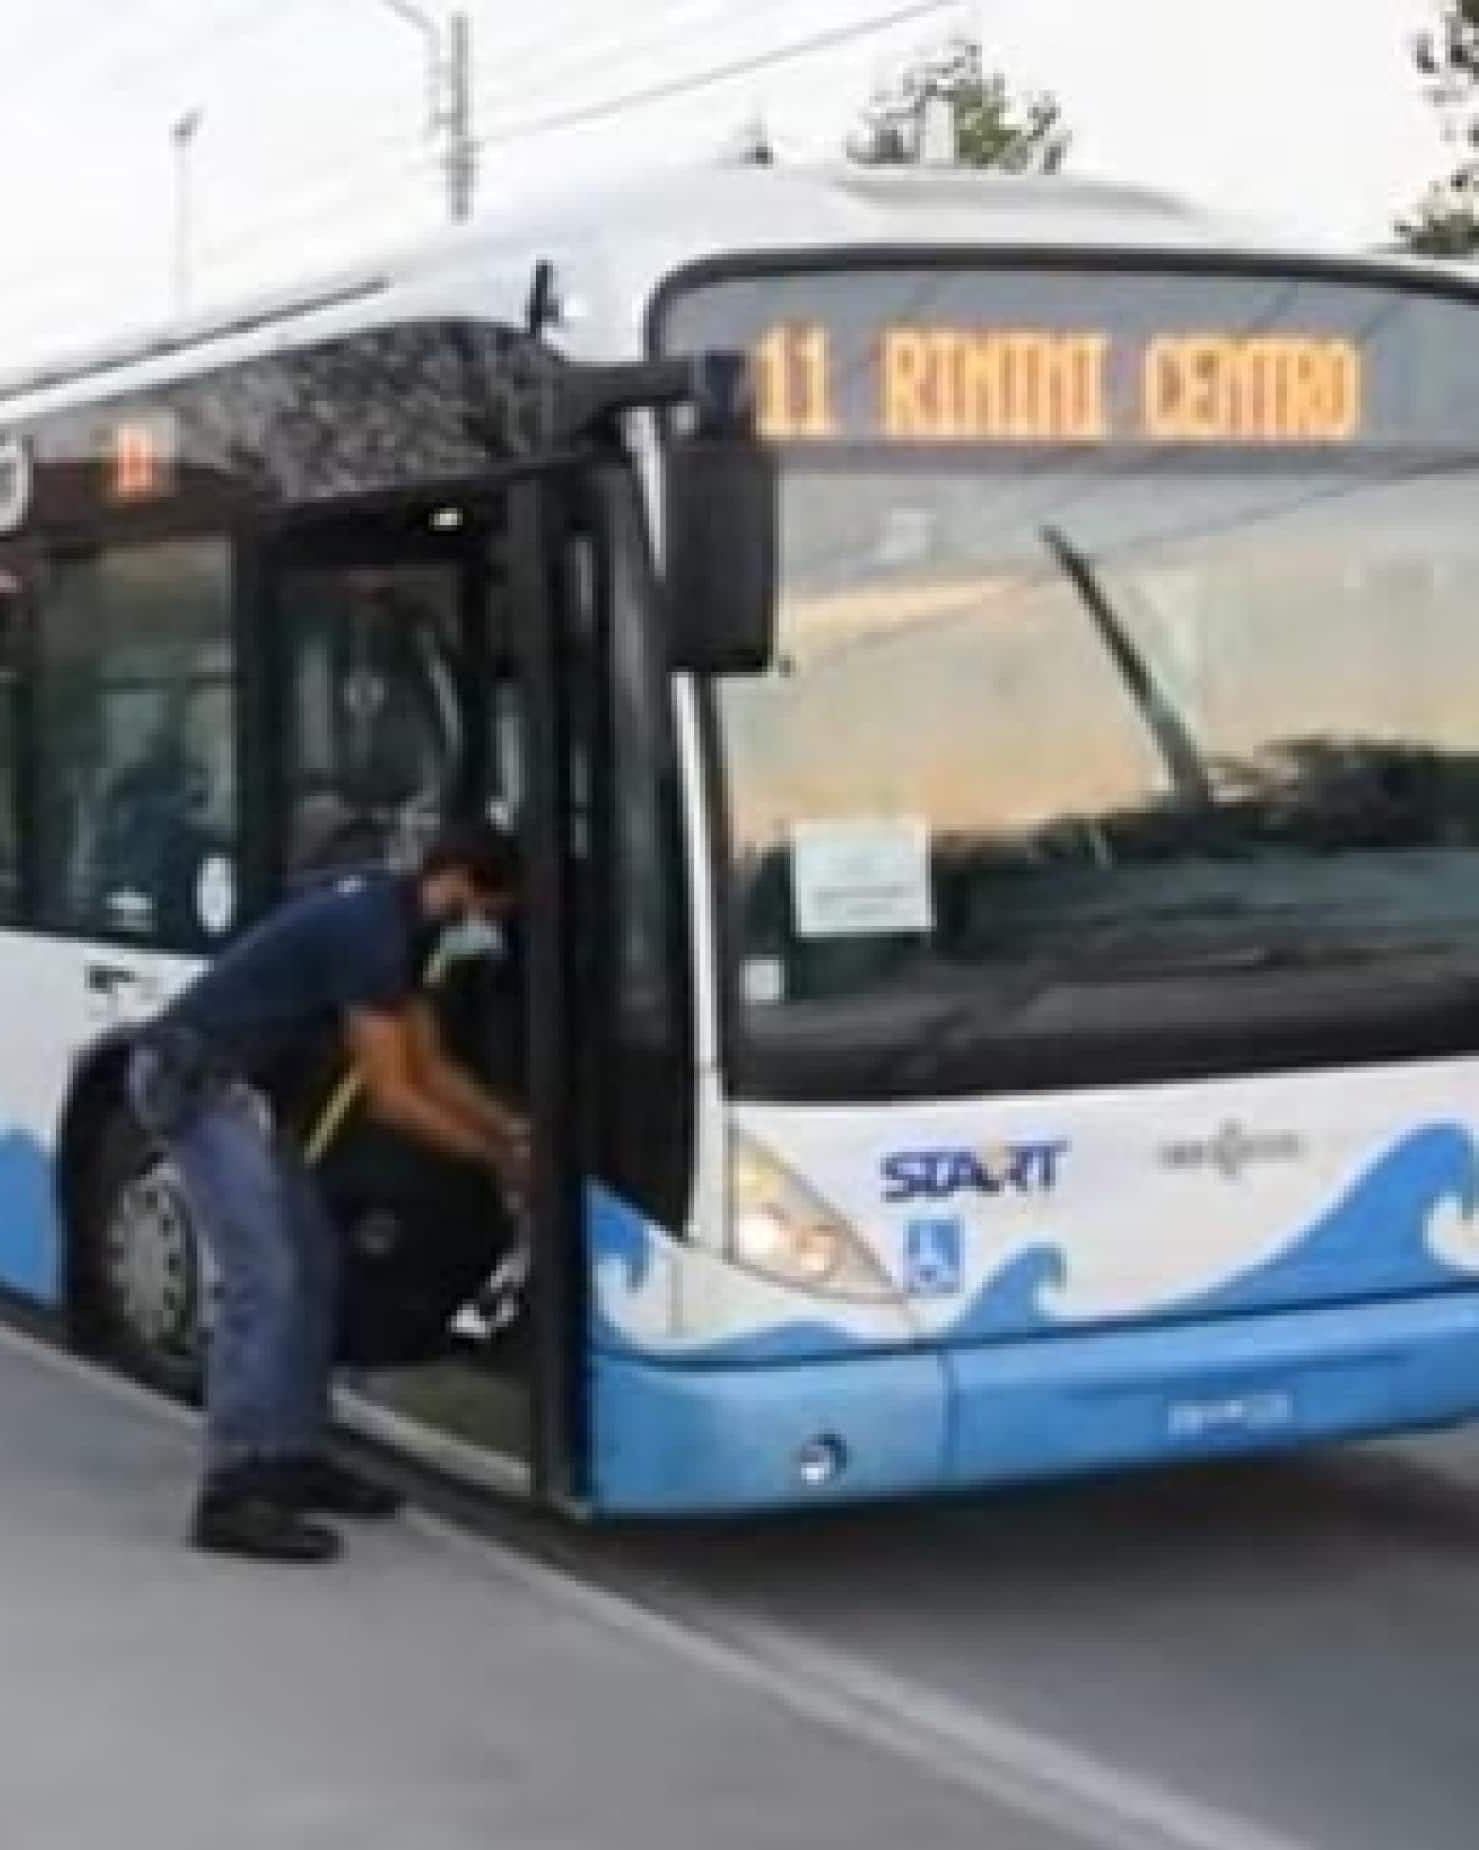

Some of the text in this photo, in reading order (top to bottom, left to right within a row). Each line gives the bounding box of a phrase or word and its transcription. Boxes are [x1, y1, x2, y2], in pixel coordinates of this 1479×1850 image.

[757, 326, 1361, 440] 11 RIMINI CENTRO
[881, 1140, 1069, 1200] START
